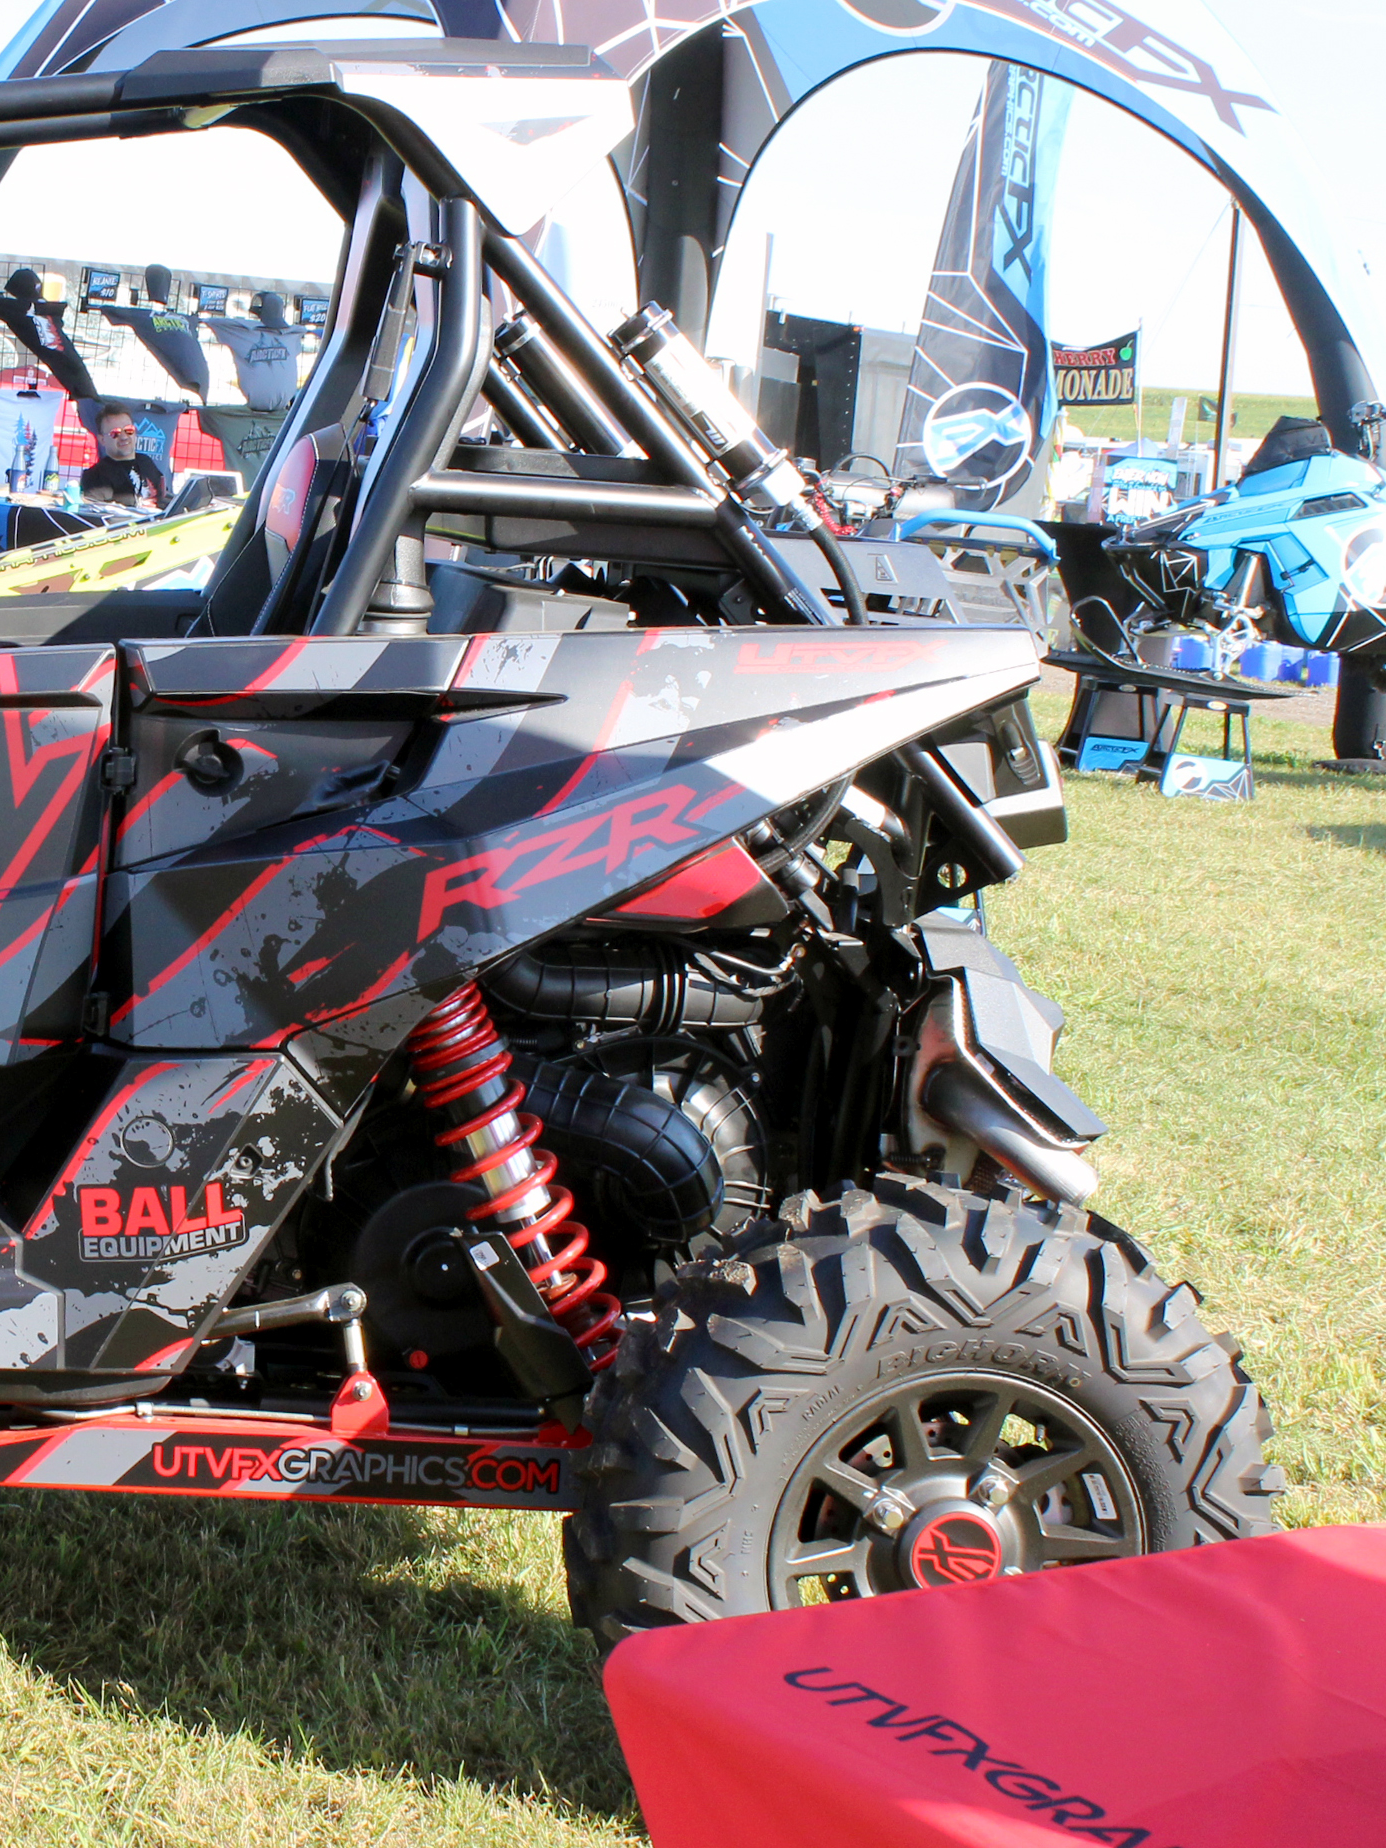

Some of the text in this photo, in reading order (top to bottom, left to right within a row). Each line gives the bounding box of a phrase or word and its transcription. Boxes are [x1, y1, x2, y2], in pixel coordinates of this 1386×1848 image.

[1107, 486, 1170, 518] WIN
[417, 784, 724, 943] RZR
[80, 1183, 242, 1238] BALL
[83, 1222, 243, 1259] EQUIPMENT
[151, 1445, 560, 1493] UTVFXGRAPHICS.COM
